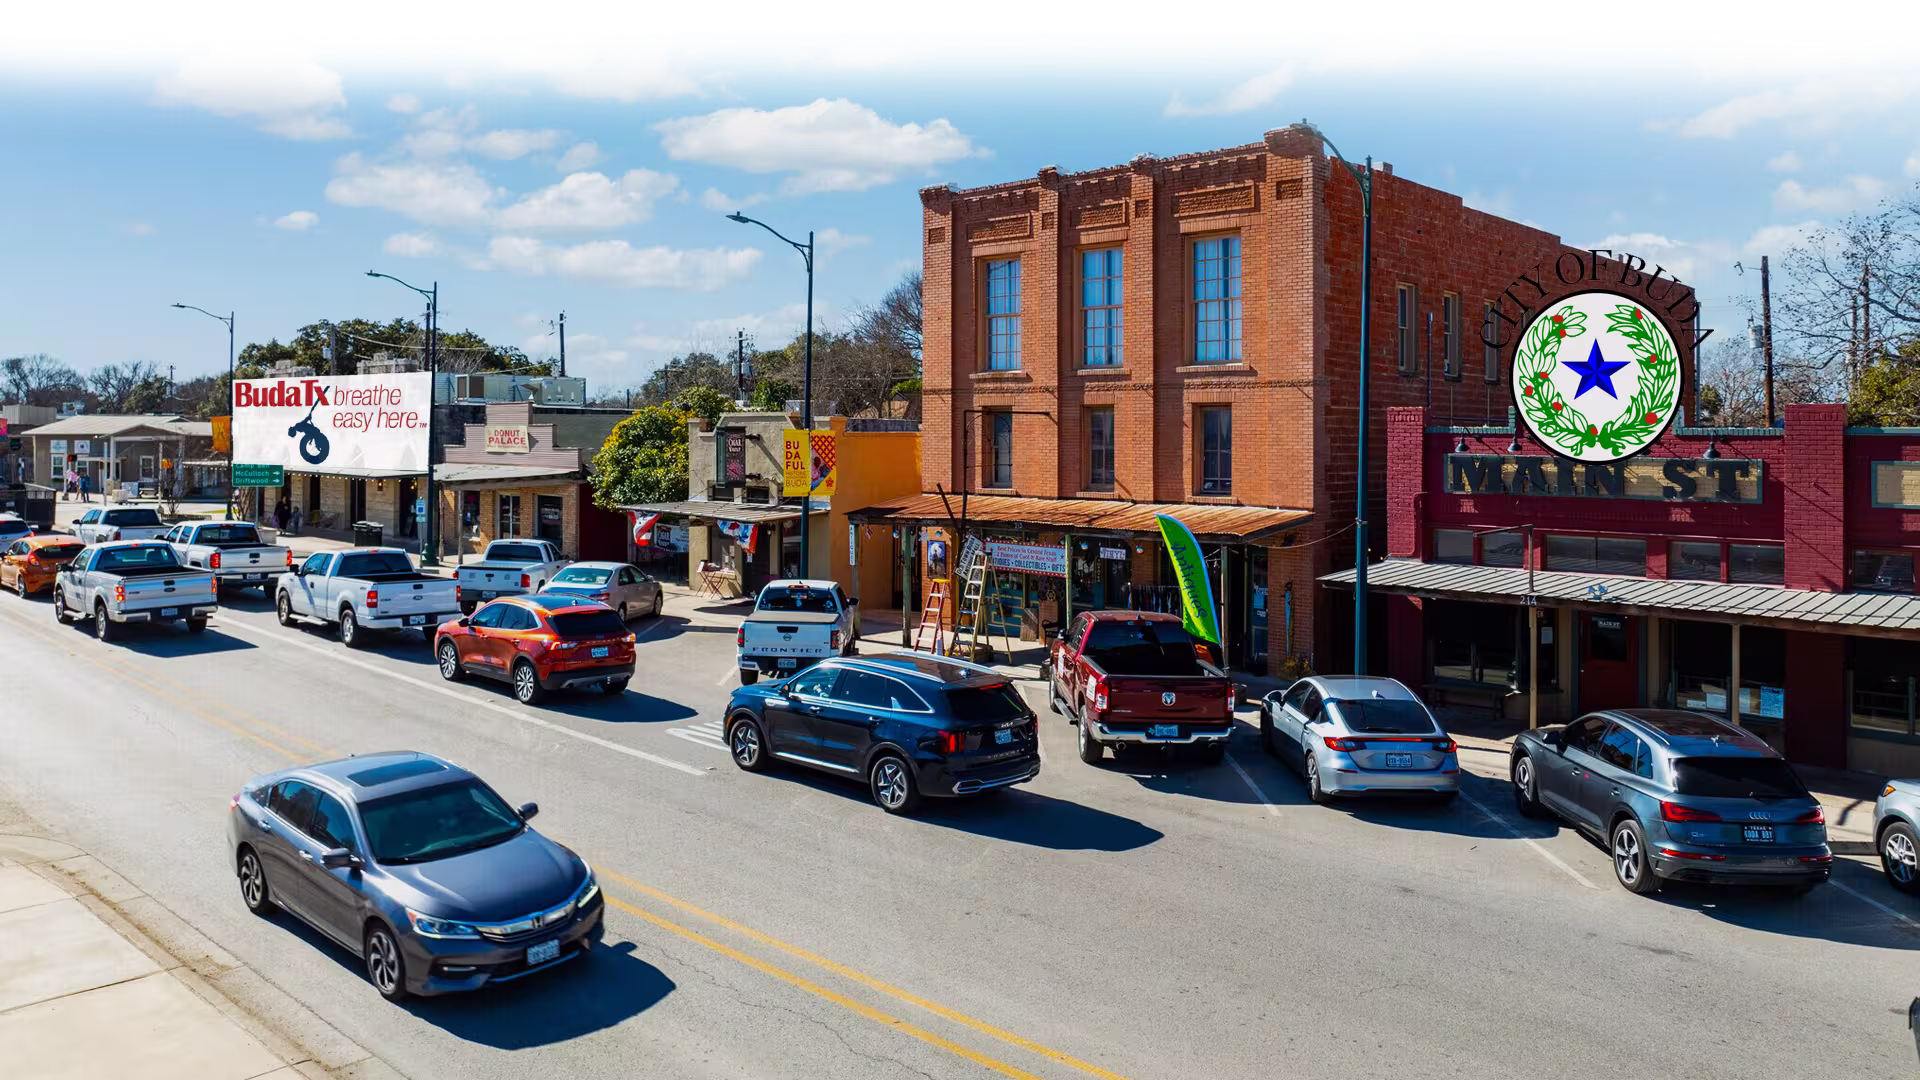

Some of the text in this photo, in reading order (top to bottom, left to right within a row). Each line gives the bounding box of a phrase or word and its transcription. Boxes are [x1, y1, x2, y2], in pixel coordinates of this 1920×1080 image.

[235, 379, 401, 407] BudaTx breathe
[332, 411, 374, 432] easy
[377, 407, 418, 429] here
[494, 429, 520, 437] DONUT
[488, 436, 526, 445] PALACE
[785, 440, 800, 450] BU
[785, 451, 801, 460] DA
[785, 461, 805, 470] FUL
[1450, 454, 1750, 501] MAIN ST
[1014, 560, 1047, 570] COLLECTIBLES
[1170, 541, 1207, 618] Antiques
[1520, 595, 1537, 606] 214
